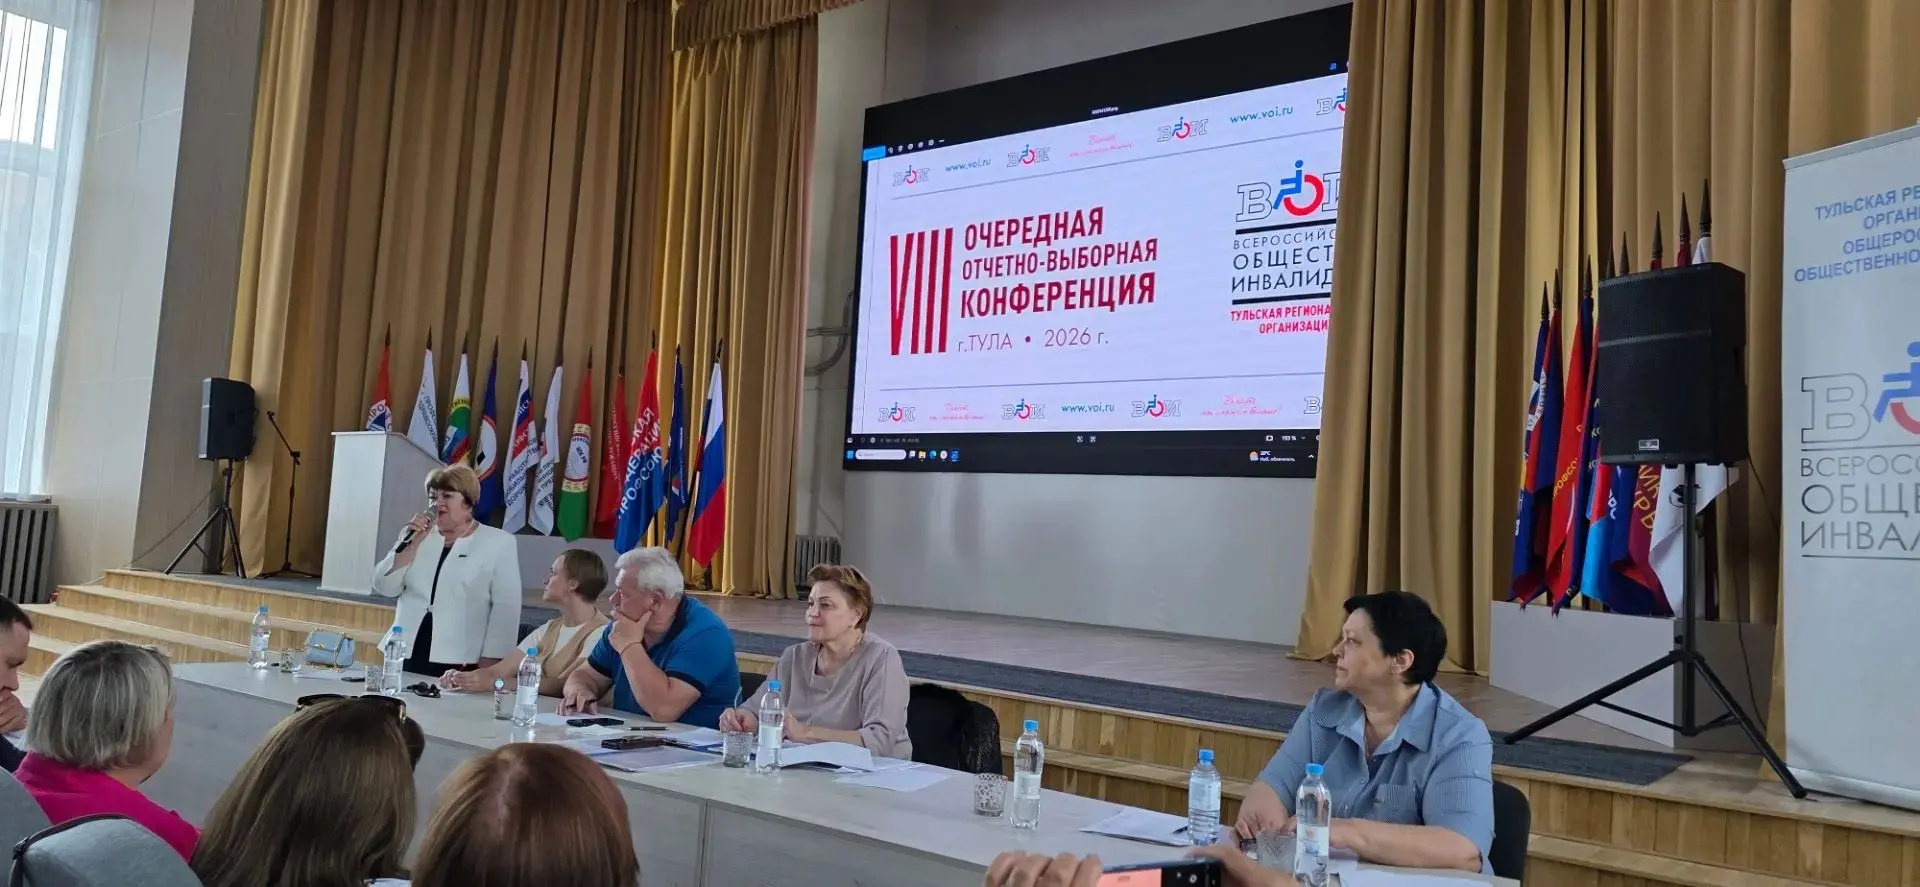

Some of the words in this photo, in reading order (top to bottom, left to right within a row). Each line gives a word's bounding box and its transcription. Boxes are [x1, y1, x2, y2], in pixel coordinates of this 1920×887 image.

[1229, 105, 1294, 124] www.voi.ru
[945, 157, 992, 172] www.voi.ru
[1814, 190, 1897, 220] ТУЛЬСКАЯ
[964, 206, 1104, 251] ОЧЕРЕДНАЯ
[1863, 207, 1920, 230] ОРГАН
[962, 238, 1158, 280] ОТЧЕТНО-ВЫБОРНАЯ
[1233, 245, 1333, 270] ОБЩЕСТ
[1794, 248, 1920, 282] ОБЩЕСТВЕННО
[889, 227, 954, 356] VIII
[960, 272, 1156, 318] КОНФЕРЕНЦИЯ
[1231, 307, 1282, 322] ТУЛЬСКАЯ
[1285, 304, 1331, 319] РЕГИОНА
[957, 333, 1013, 352] г.ТУЛА
[1044, 327, 1091, 348] 2026
[1097, 331, 1109, 345] г.
[1061, 401, 1115, 413] www.voi.ru
[1304, 396, 1321, 415] В
